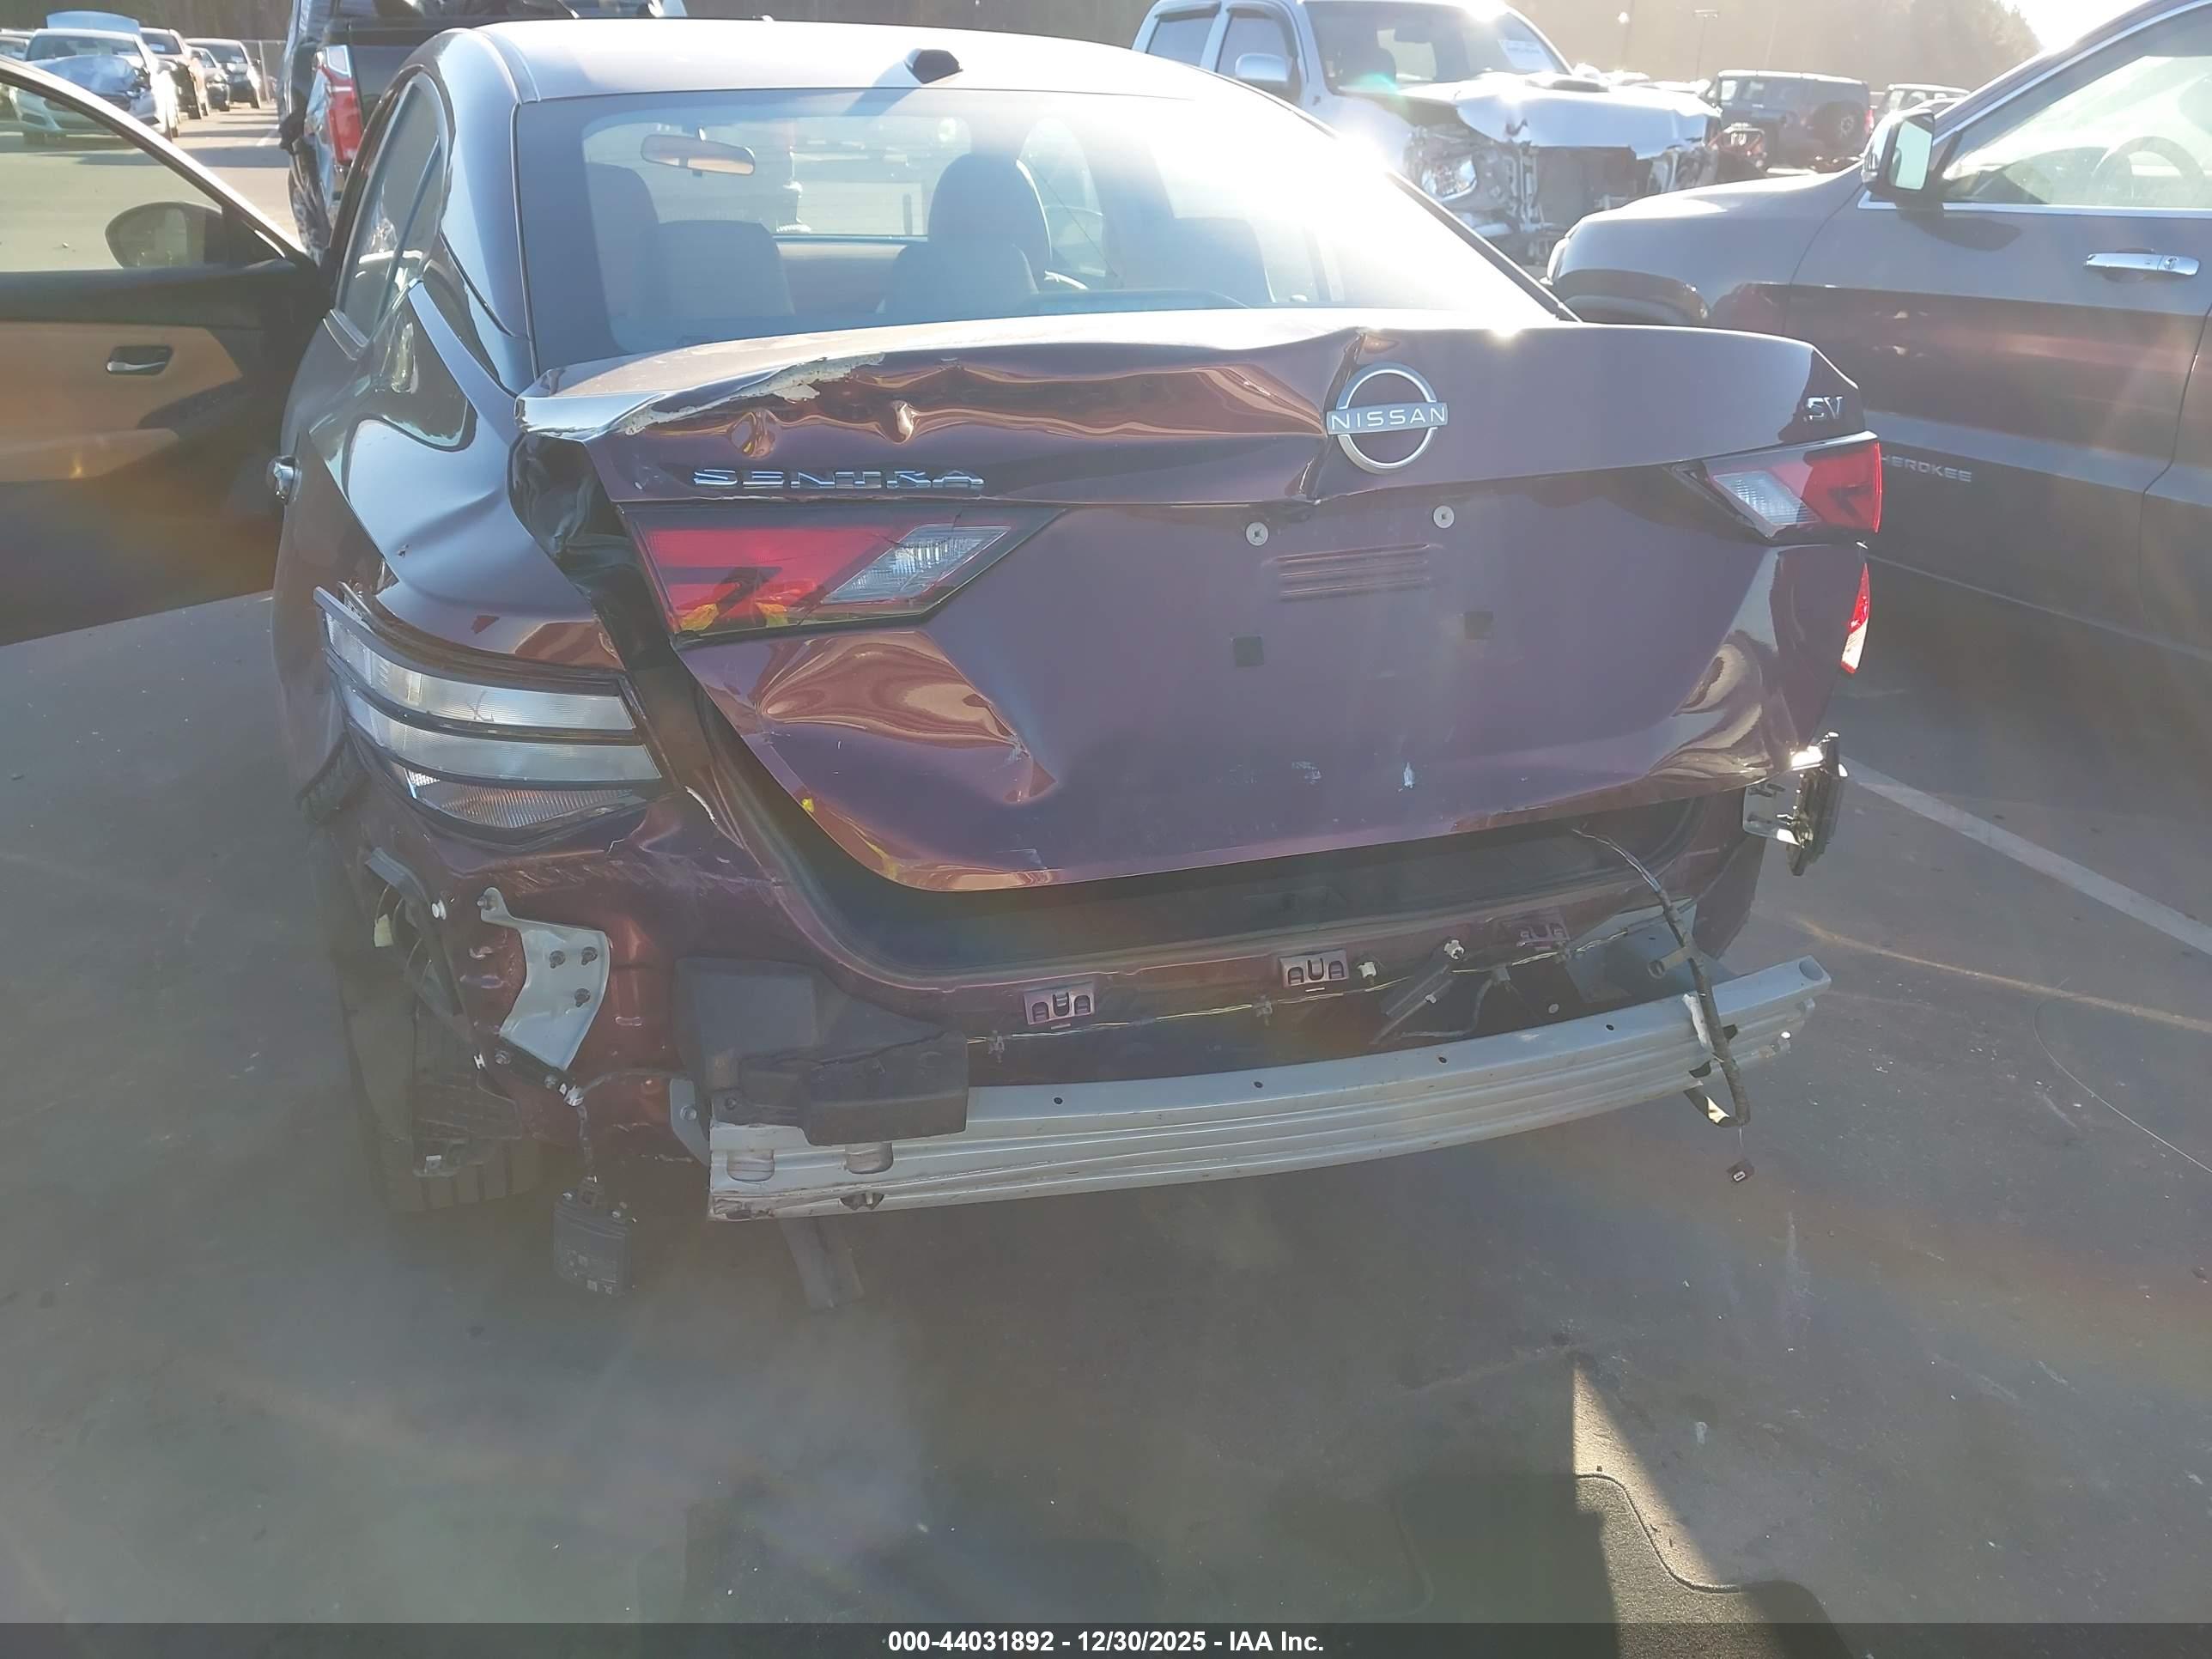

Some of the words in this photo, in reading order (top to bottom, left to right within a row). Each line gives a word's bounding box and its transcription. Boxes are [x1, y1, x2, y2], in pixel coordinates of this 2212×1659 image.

[1331, 406, 1446, 431] NISSAN
[1808, 395, 1844, 420] SV
[693, 468, 985, 489] SENTRA
